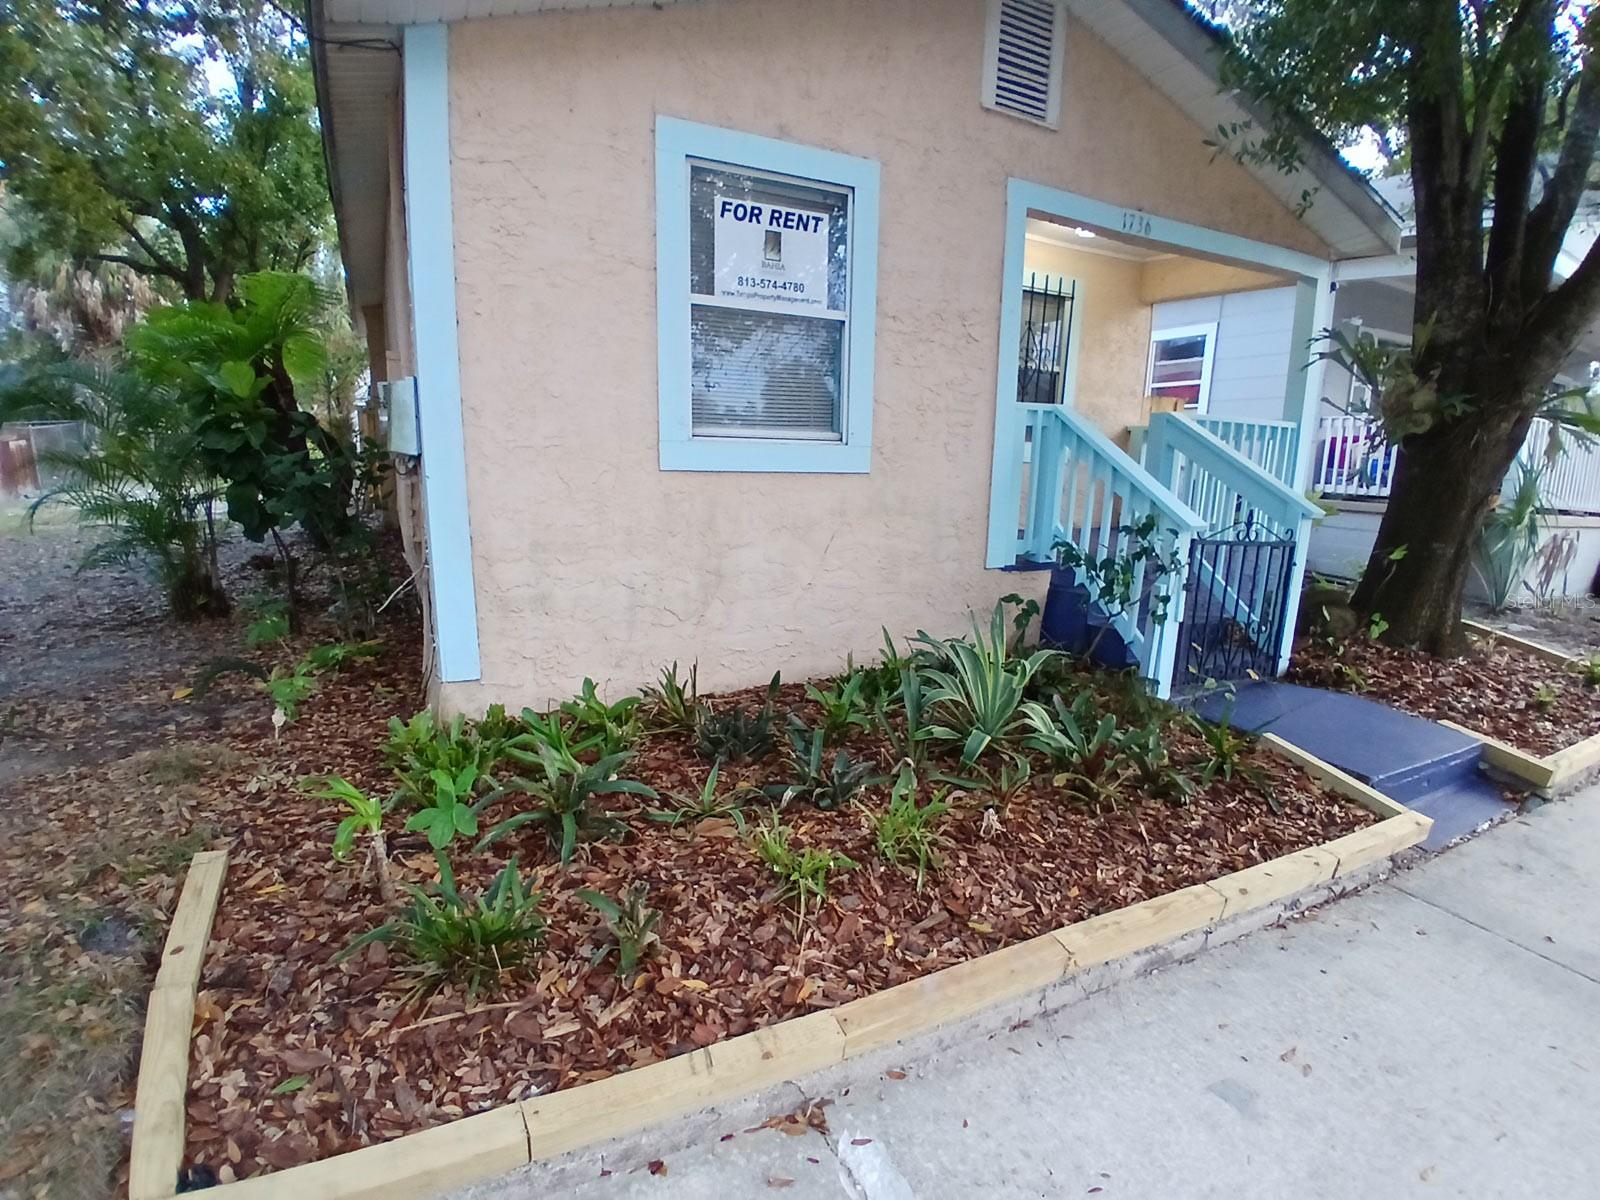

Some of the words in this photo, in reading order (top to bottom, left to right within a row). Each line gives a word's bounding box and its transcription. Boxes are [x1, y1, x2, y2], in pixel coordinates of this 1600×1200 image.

[720, 200, 763, 225] FOR
[768, 208, 824, 234] RENT
[737, 276, 805, 293] 813-574-4780
